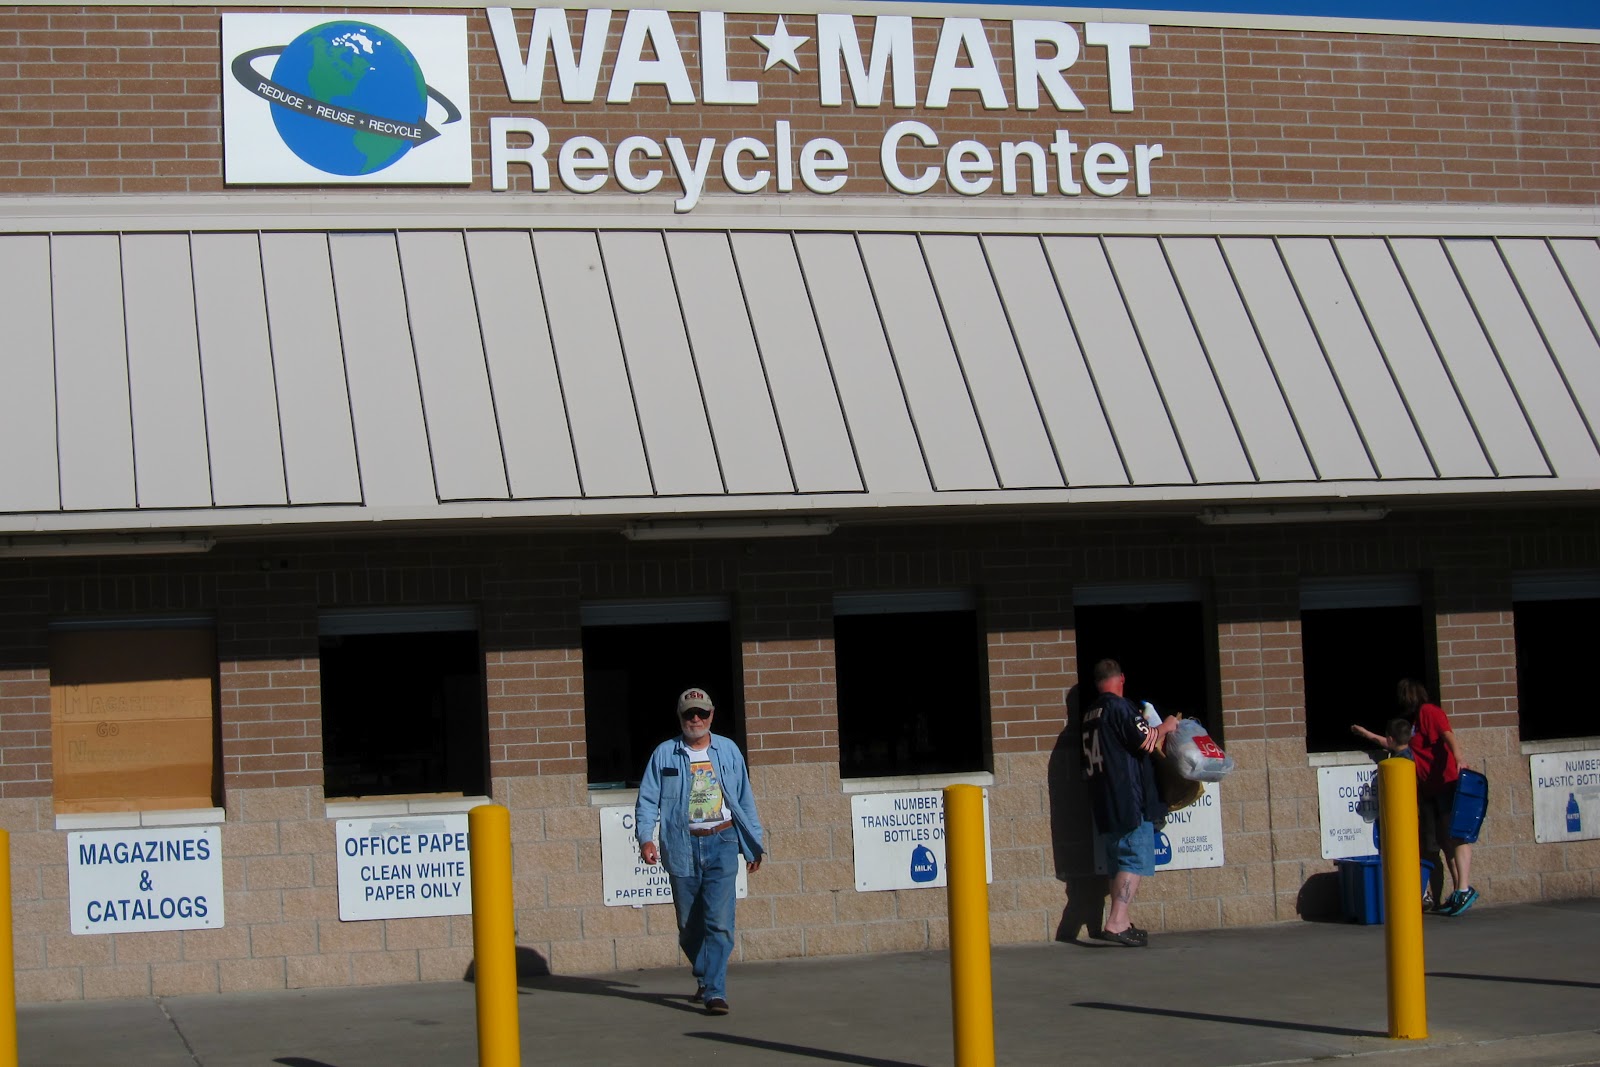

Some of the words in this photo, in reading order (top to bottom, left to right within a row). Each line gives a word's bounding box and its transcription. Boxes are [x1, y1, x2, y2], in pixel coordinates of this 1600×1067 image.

[257, 82, 304, 110] REDUCE
[316, 104, 355, 125] REUSE
[368, 119, 422, 140] RECYCLE
[489, 116, 849, 213] Recycle
[880, 120, 1164, 197] Center
[1082, 728, 1104, 777] 54
[1539, 775, 1574, 788] PLASTIC
[894, 797, 938, 811] NUMBER
[862, 812, 936, 828] TRANSLUCENT
[1167, 811, 1192, 824] ONLY
[884, 829, 930, 843] BOTTLES
[79, 838, 211, 865] MAGAZINES
[345, 835, 411, 857] OFFICE
[360, 864, 411, 881] CLEAN
[416, 861, 465, 878] WHITE
[914, 864, 932, 872] MILK
[139, 869, 153, 891] &
[365, 884, 415, 901] PAPER
[421, 882, 461, 899] ONLY
[616, 888, 652, 899] PAPER
[86, 895, 208, 922] CATALOGS
